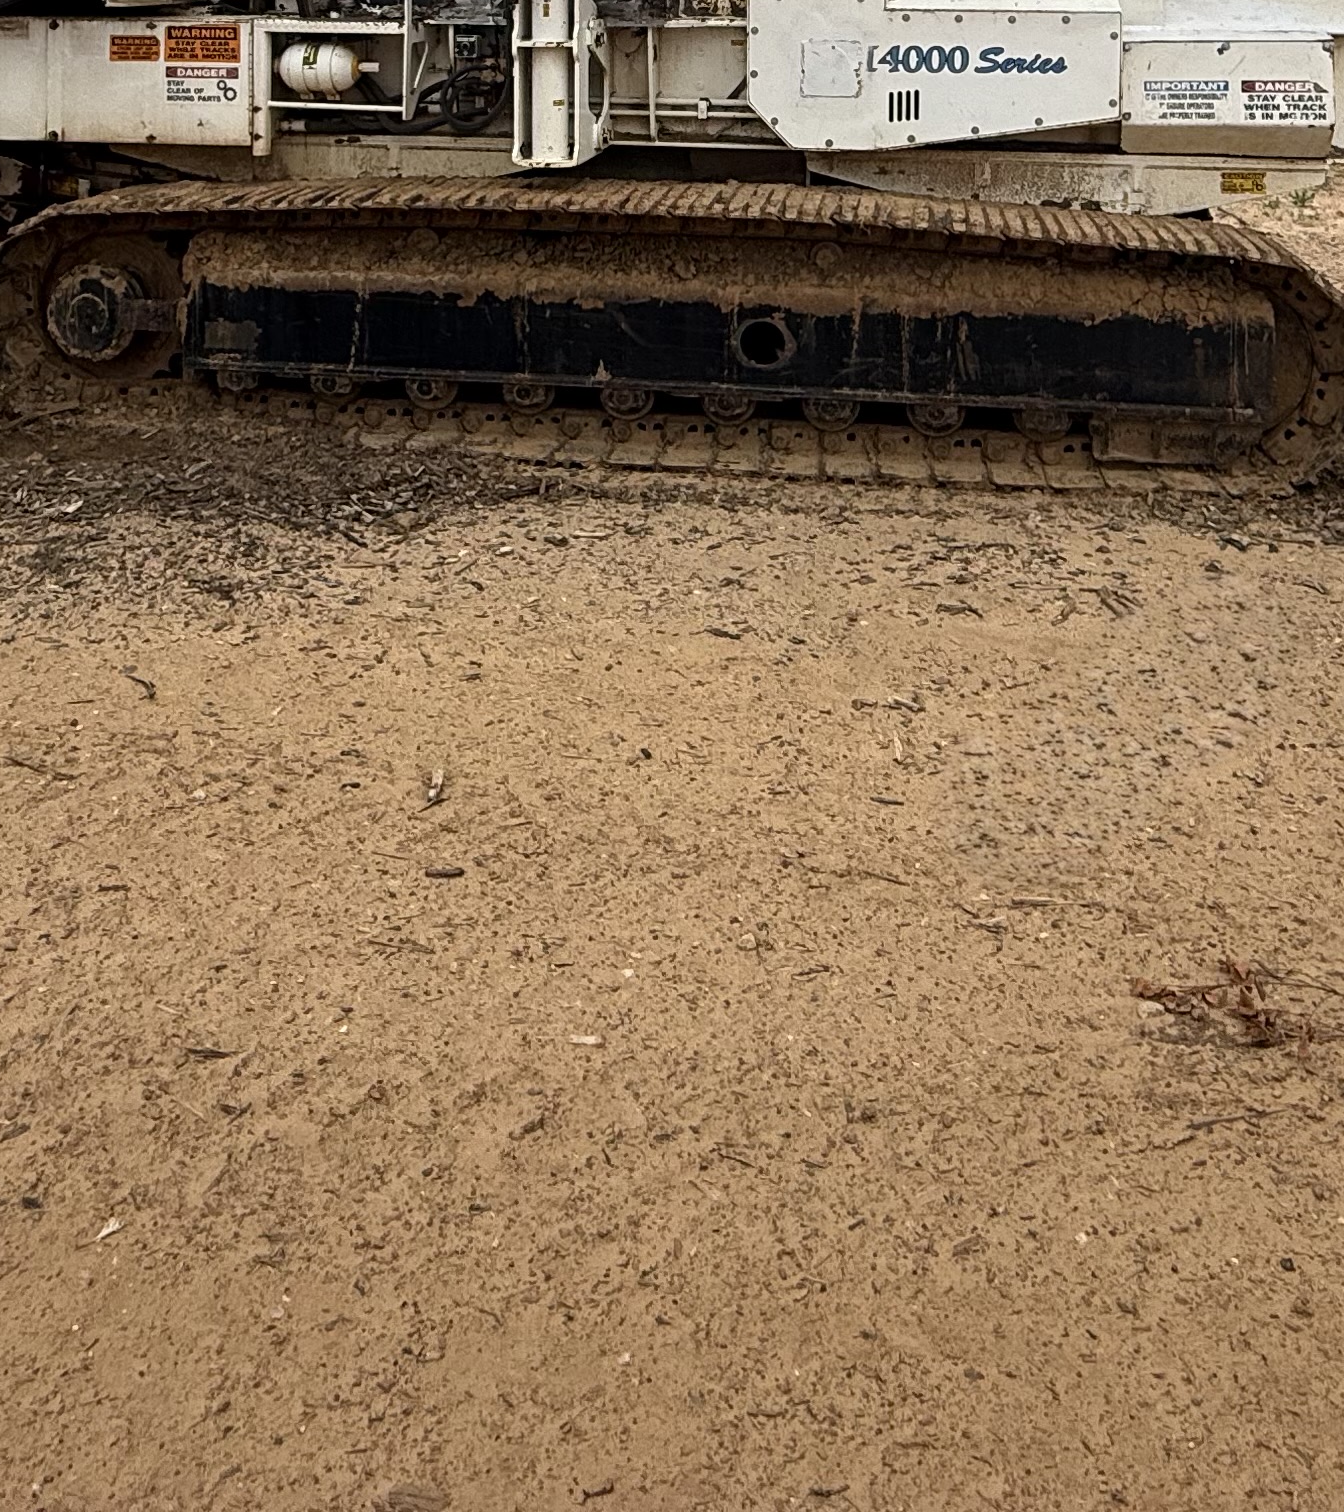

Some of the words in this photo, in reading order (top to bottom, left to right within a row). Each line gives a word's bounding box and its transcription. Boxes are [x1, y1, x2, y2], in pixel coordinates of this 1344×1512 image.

[171, 29, 235, 38] WARNING
[974, 47, 1068, 74] Series
[177, 69, 227, 77] DANGER
[1146, 82, 1226, 90] IMPORTANT
[1256, 82, 1314, 91] DANGER
